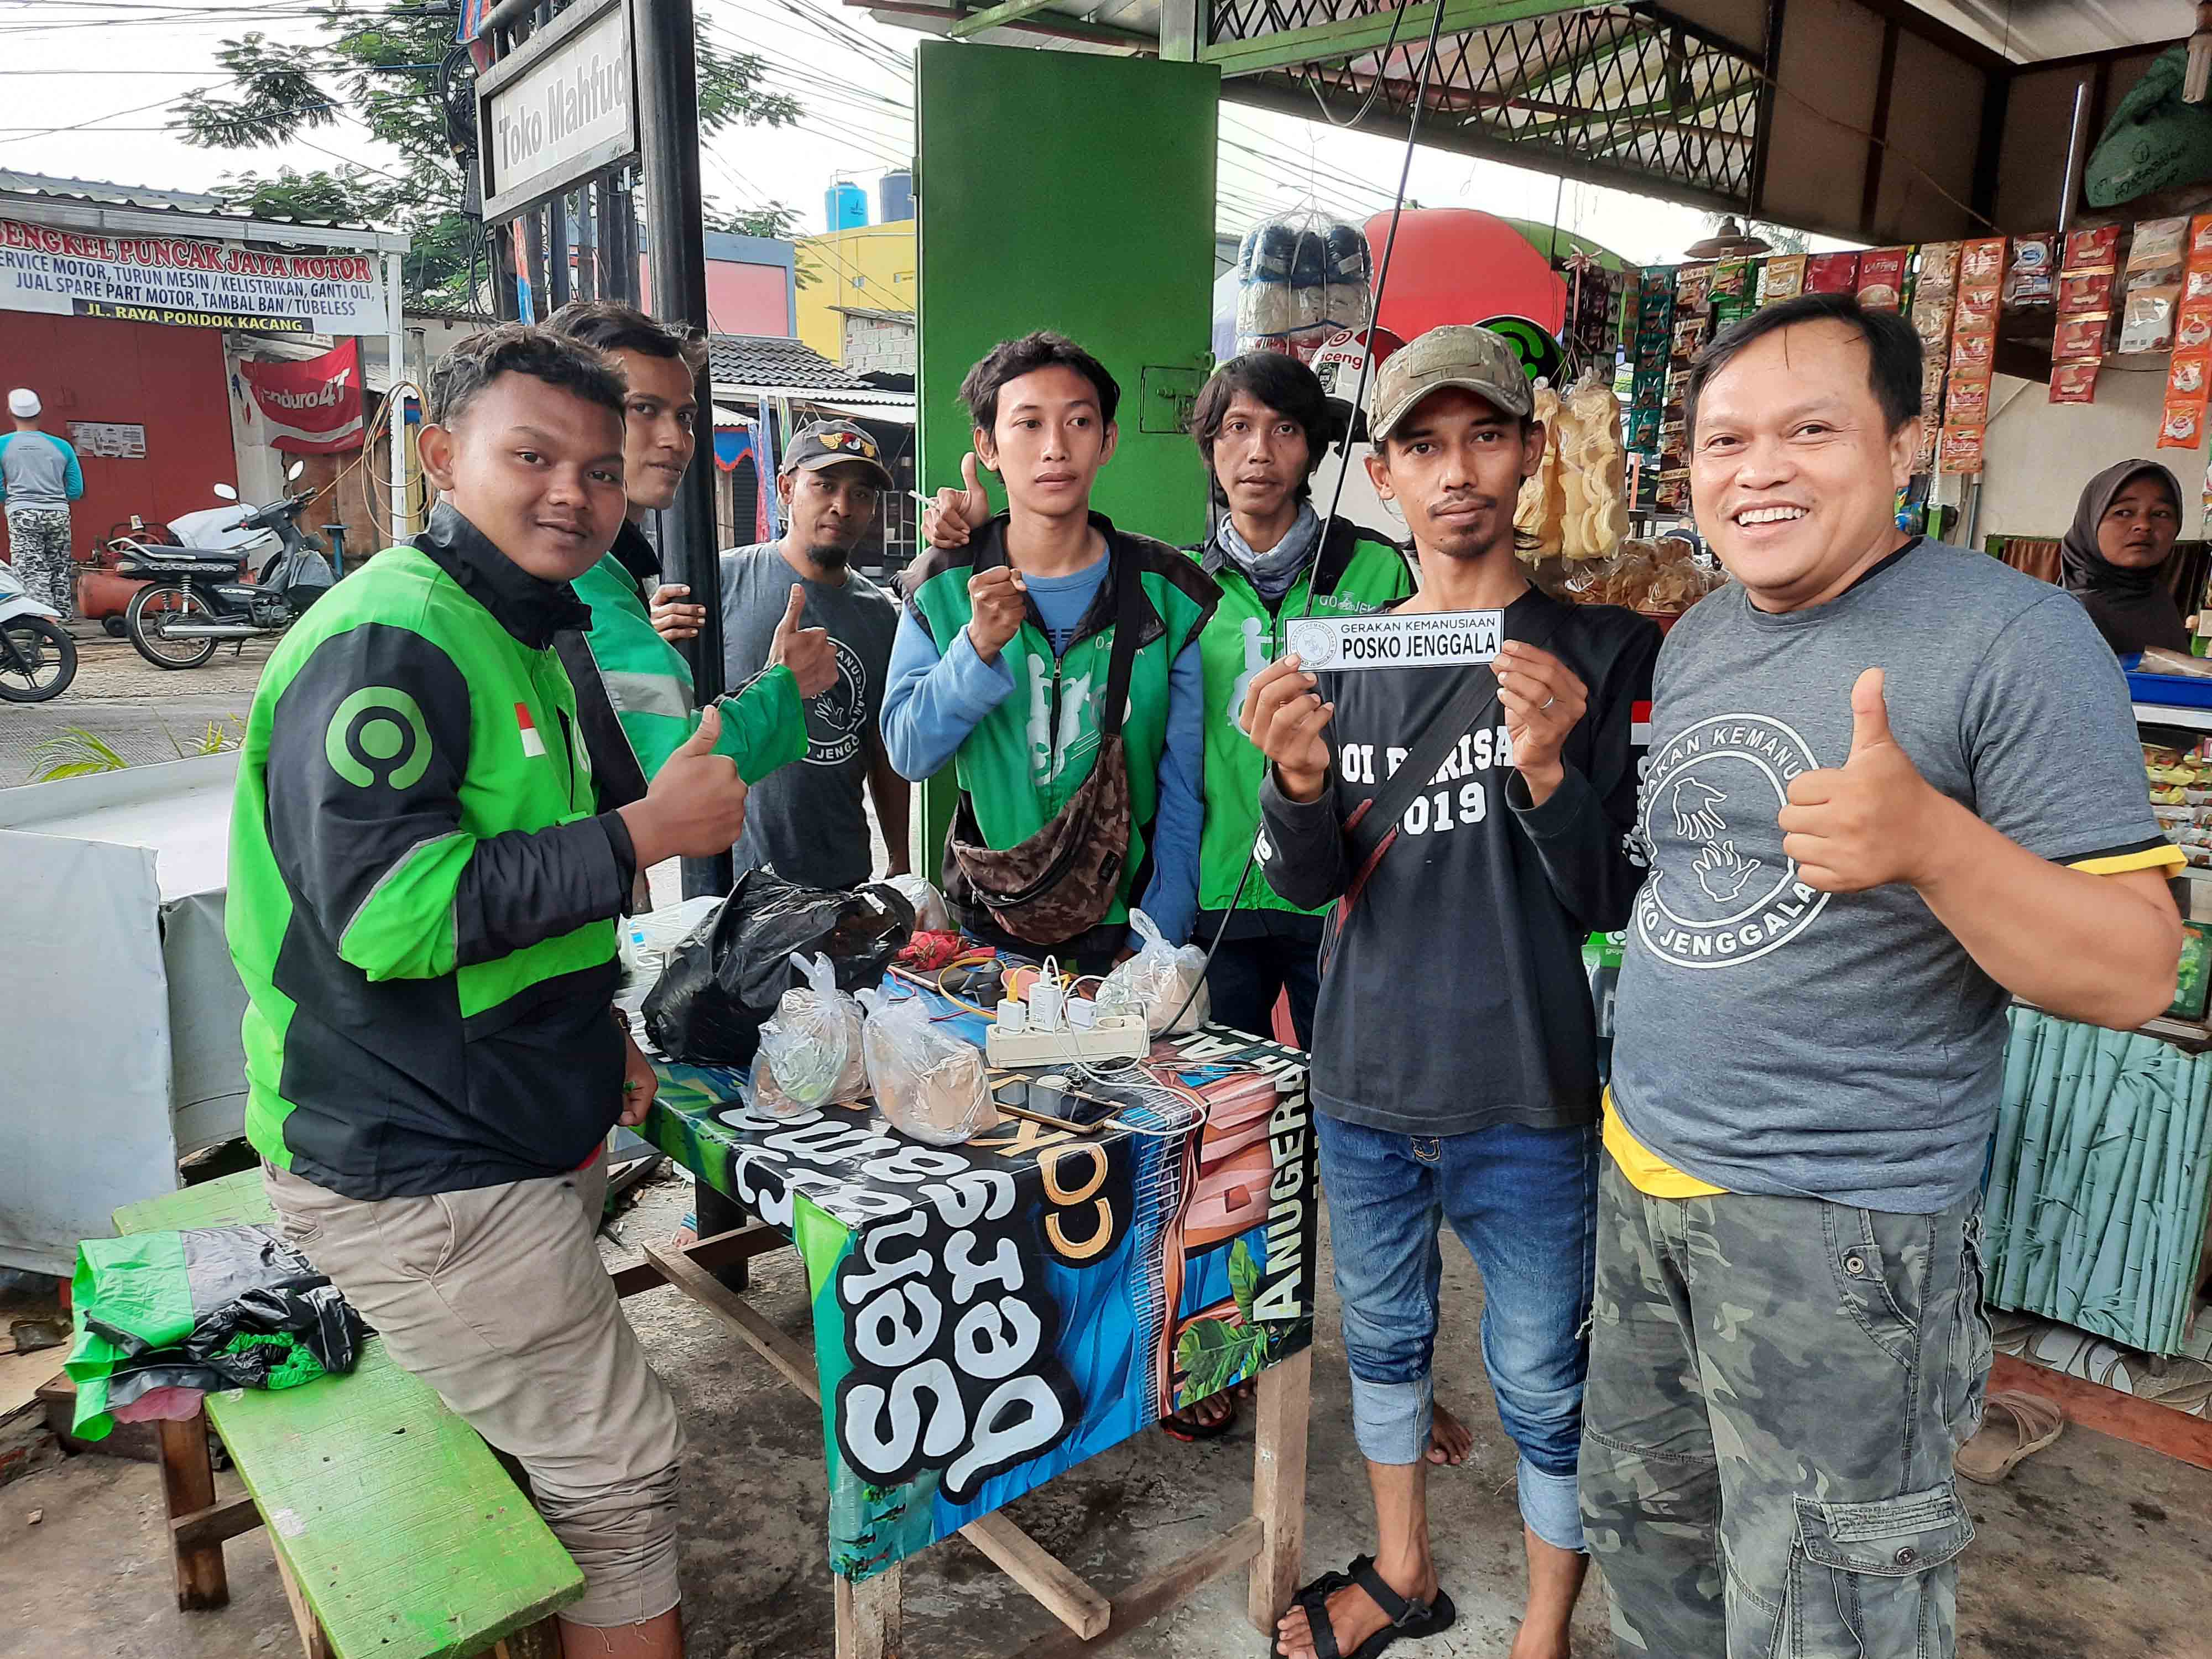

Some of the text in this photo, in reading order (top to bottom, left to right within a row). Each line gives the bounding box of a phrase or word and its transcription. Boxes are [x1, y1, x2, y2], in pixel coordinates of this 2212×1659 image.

[499, 103, 541, 170] Toko
[54, 258, 111, 281] MOTOR,
[113, 266, 162, 286] TURUN
[167, 272, 208, 290] MESIN
[213, 275, 217, 291] /
[221, 276, 306, 299] KELISTRIKAN,
[311, 283, 347, 299] GANTI
[351, 285, 374, 302] OLI,
[117, 238, 223, 272] PUNCAK
[227, 249, 290, 278] JAYA
[292, 257, 373, 282] MOTOR
[16, 273, 356, 315] JUAL SPARE PART MOTOR, TAMBAL BAN / TUBELESS
[87, 303, 303, 331] JL. RAYA PONDOK KACANG
[1341, 618, 1495, 633] GERAKAN KEMANUSIAAN
[1343, 632, 1496, 659] POSKO JENGGALA
[1339, 743, 1375, 784] OI
[1713, 726, 1803, 781] KEMANU
[1397, 782, 1487, 835] 019
[1659, 881, 1817, 956] JENGGALA
